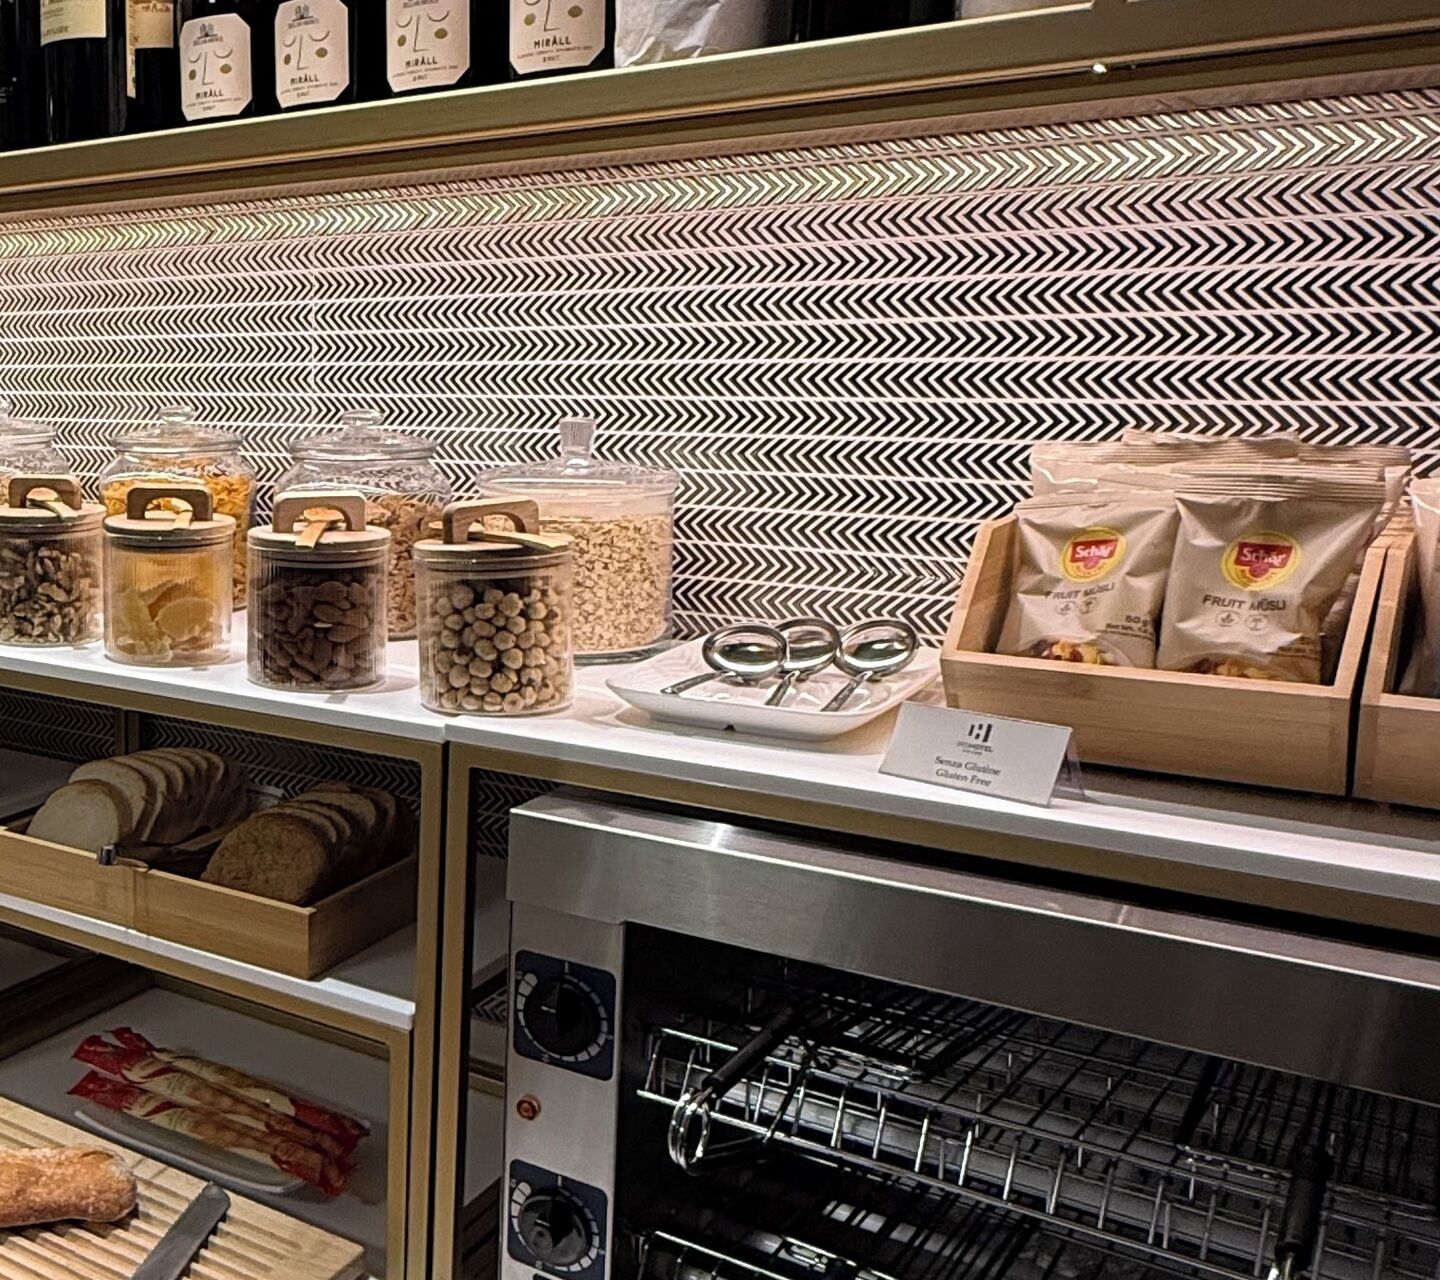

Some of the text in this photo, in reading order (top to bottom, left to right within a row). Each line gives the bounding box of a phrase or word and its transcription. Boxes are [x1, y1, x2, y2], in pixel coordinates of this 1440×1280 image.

[1074, 541, 1115, 559] Schär
[1240, 547, 1287, 566] Schär
[1045, 589, 1081, 600] FRUIT
[1202, 594, 1287, 612] FRUIT MÜSLI
[934, 754, 962, 770] Senza
[969, 772, 993, 788] Free
